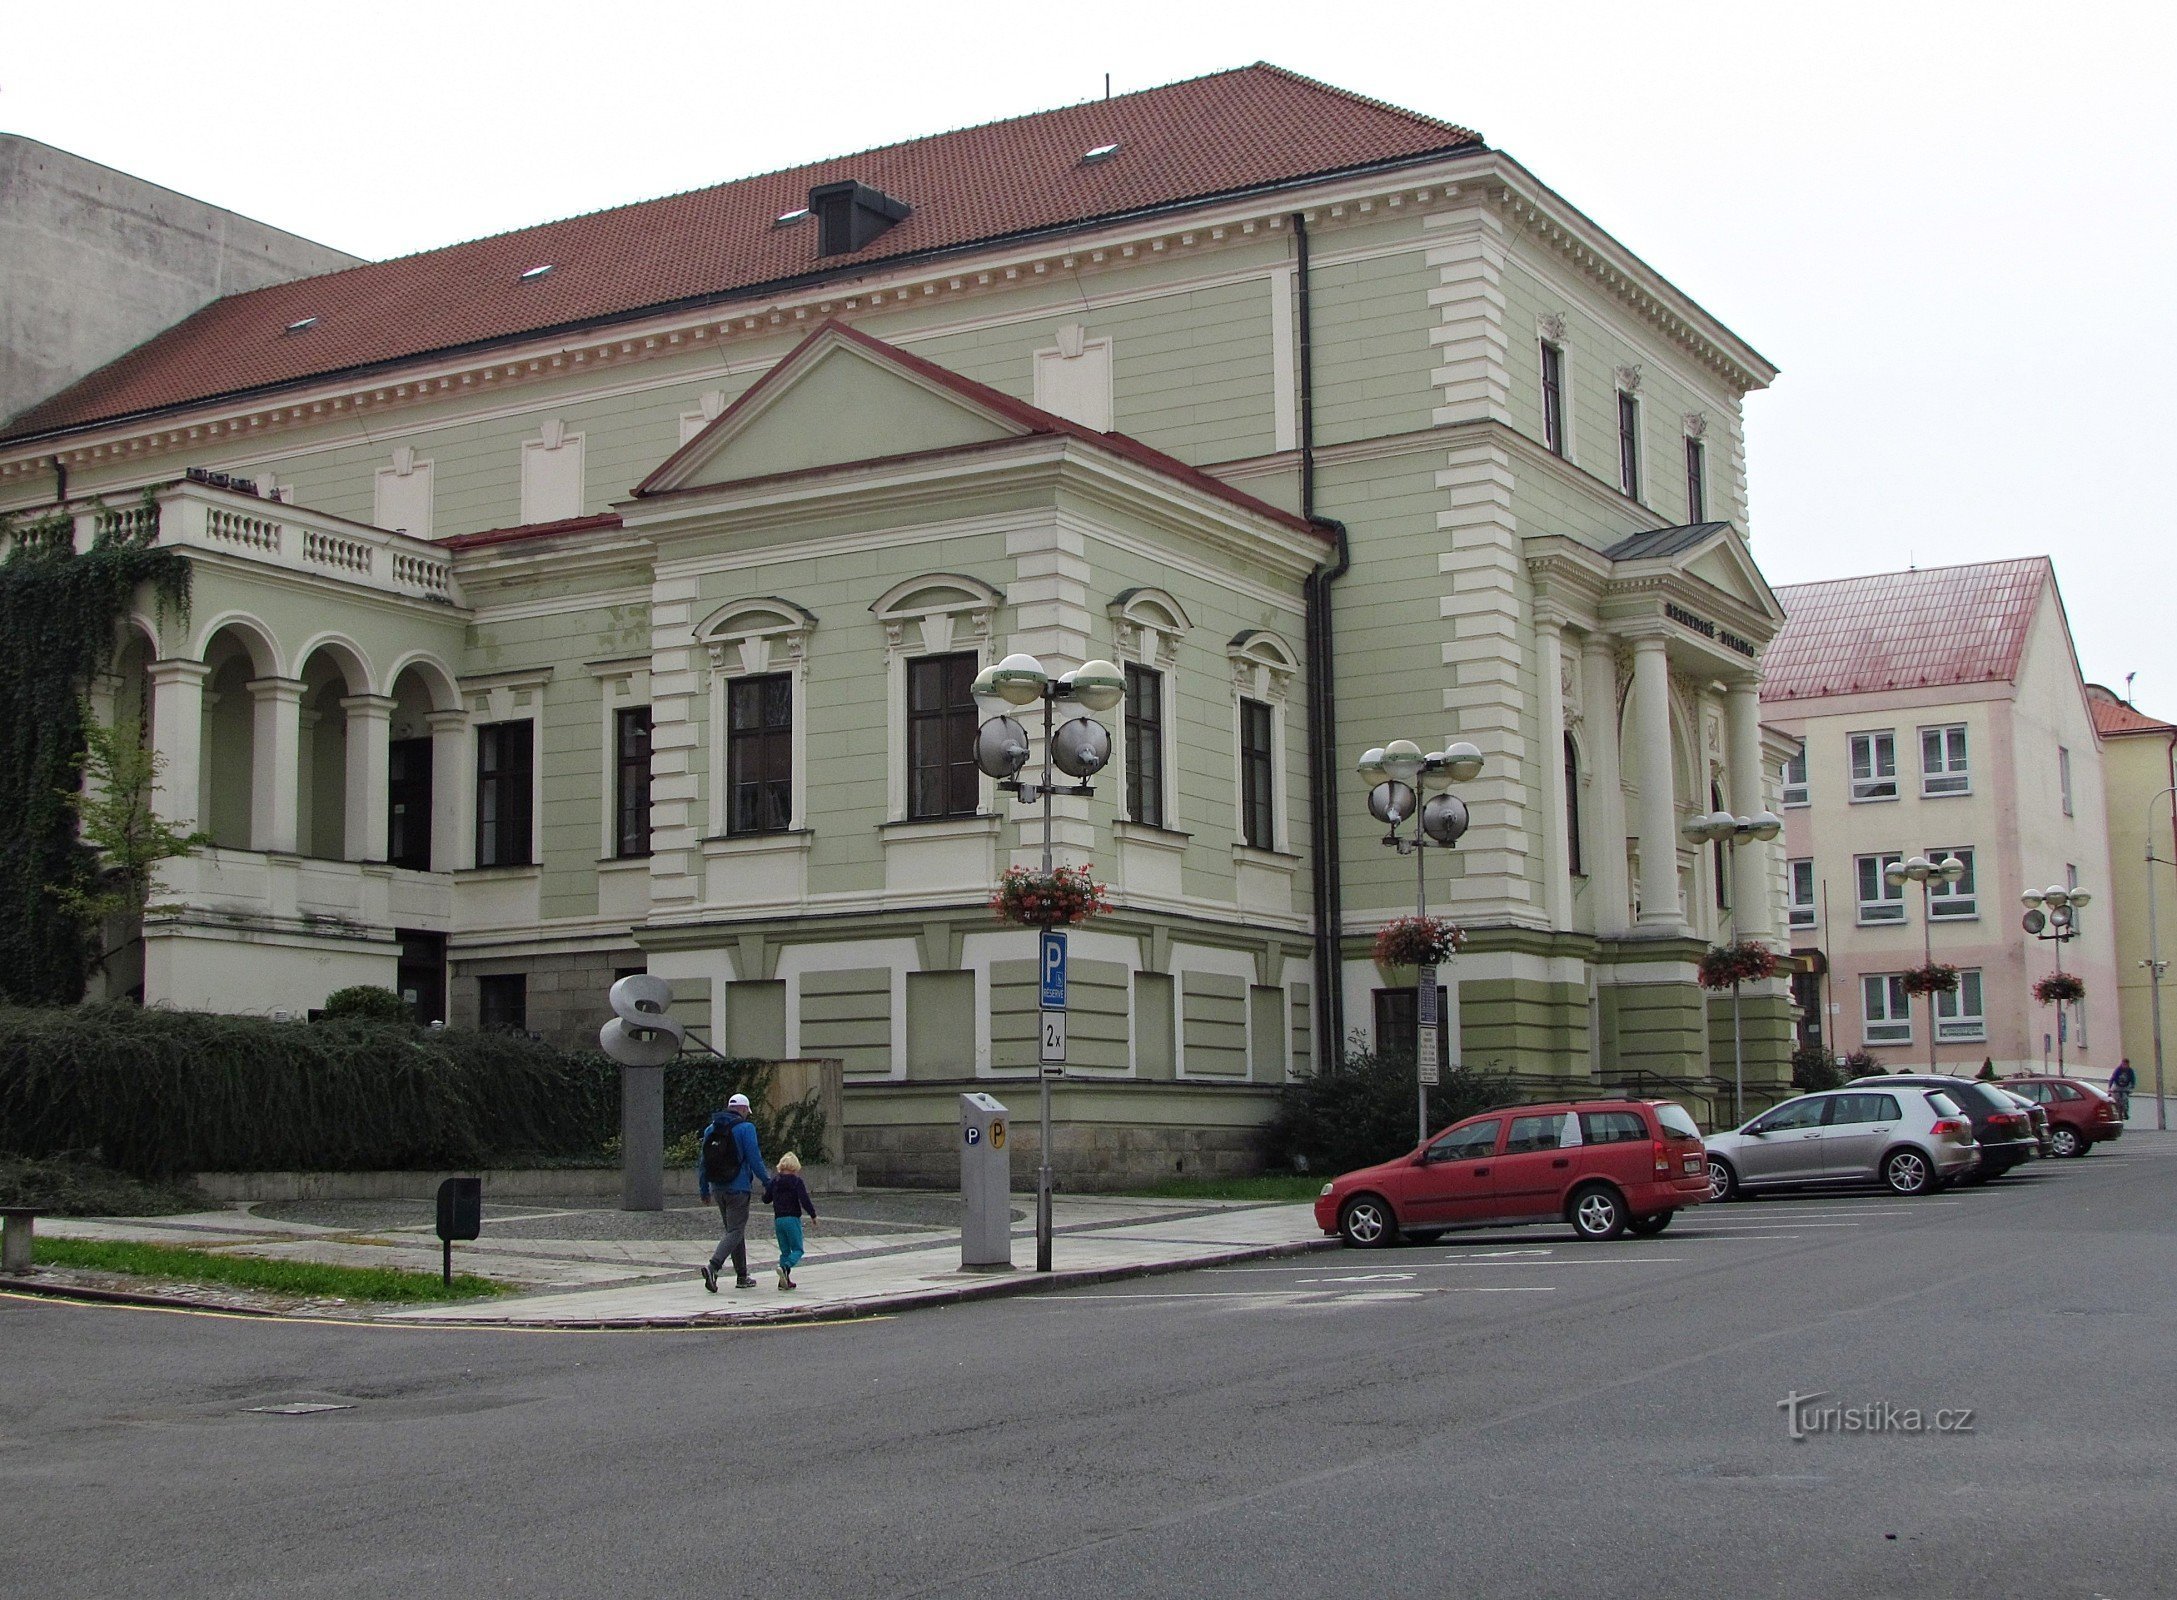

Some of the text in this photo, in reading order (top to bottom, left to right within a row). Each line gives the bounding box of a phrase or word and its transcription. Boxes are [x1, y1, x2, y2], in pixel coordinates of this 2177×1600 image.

[1046, 941, 1062, 983] P
[968, 1128, 978, 1144] P
[994, 1122, 1003, 1145] P
